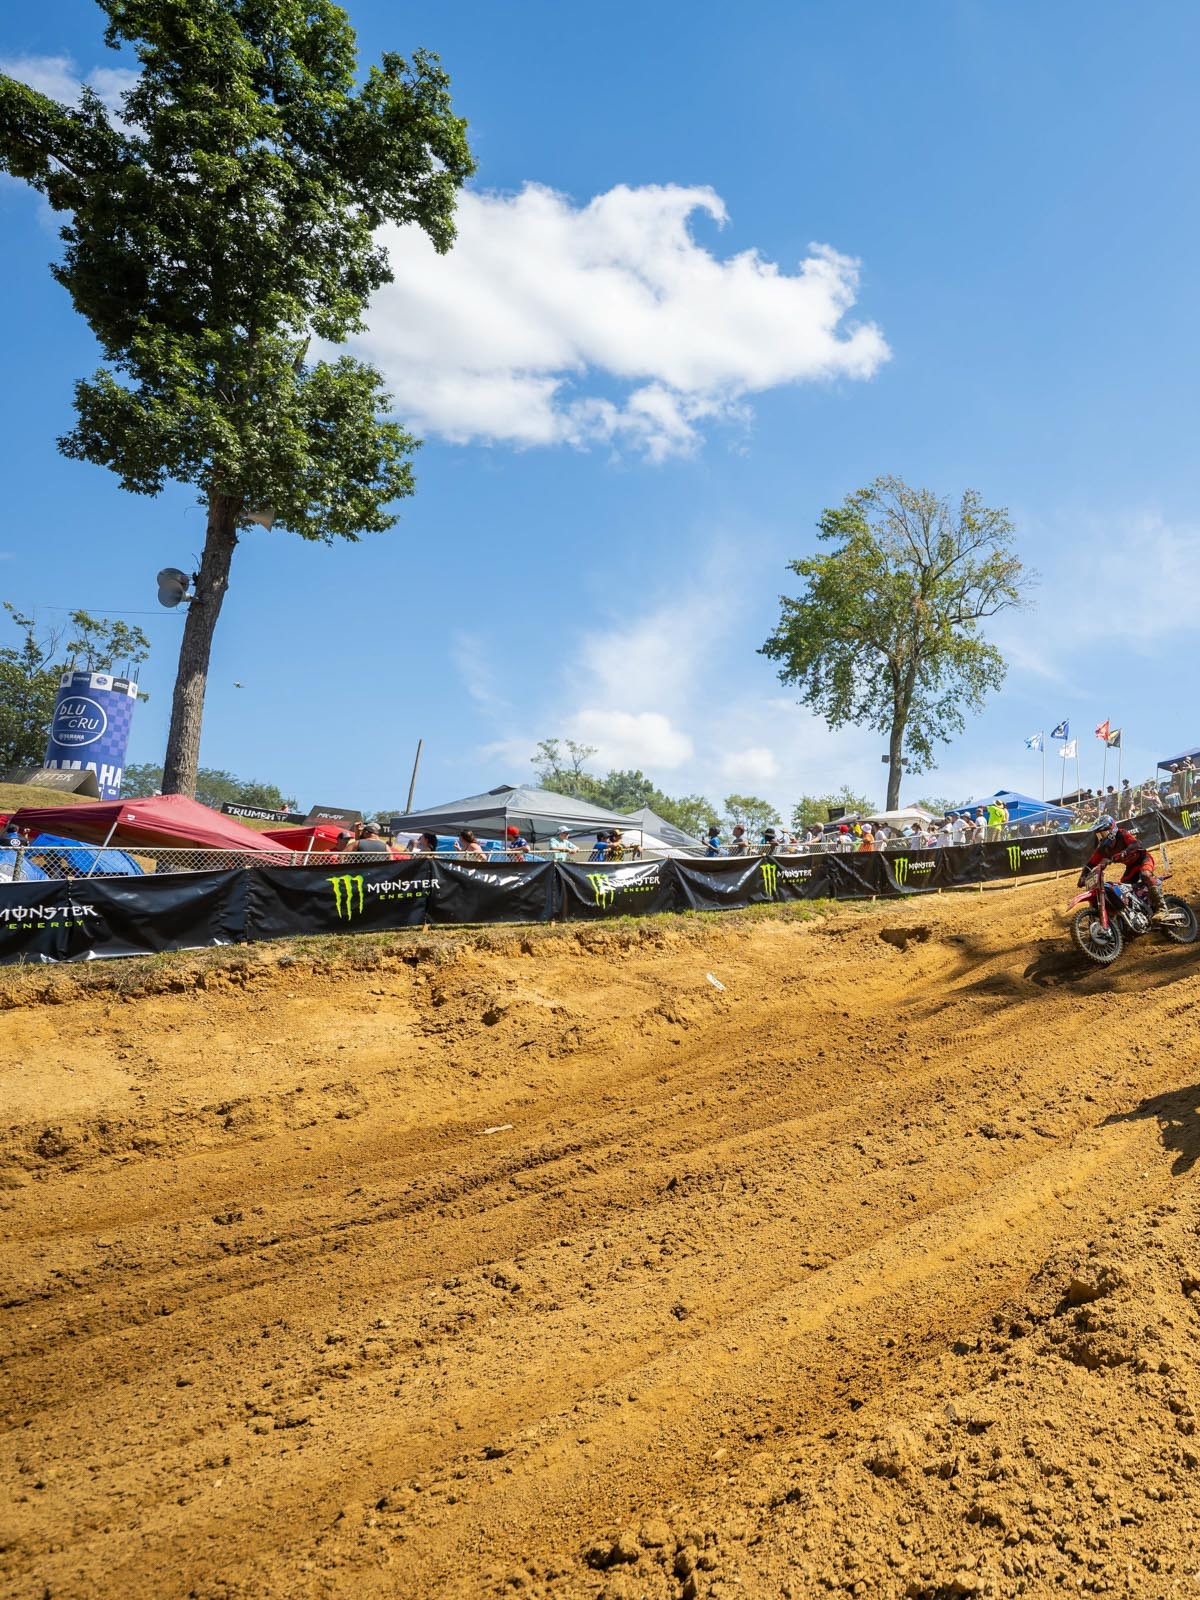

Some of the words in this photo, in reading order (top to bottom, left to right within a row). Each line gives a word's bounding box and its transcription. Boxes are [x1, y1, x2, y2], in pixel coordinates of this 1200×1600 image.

[227, 806, 275, 821] TRIUMPH
[908, 860, 936, 870] MONSTER
[777, 869, 812, 878] MONSTER
[367, 879, 440, 893] MONSTER
[380, 891, 430, 900] ENERGY
[0, 905, 98, 921] MONSTER
[8, 920, 84, 930] ENERGY
